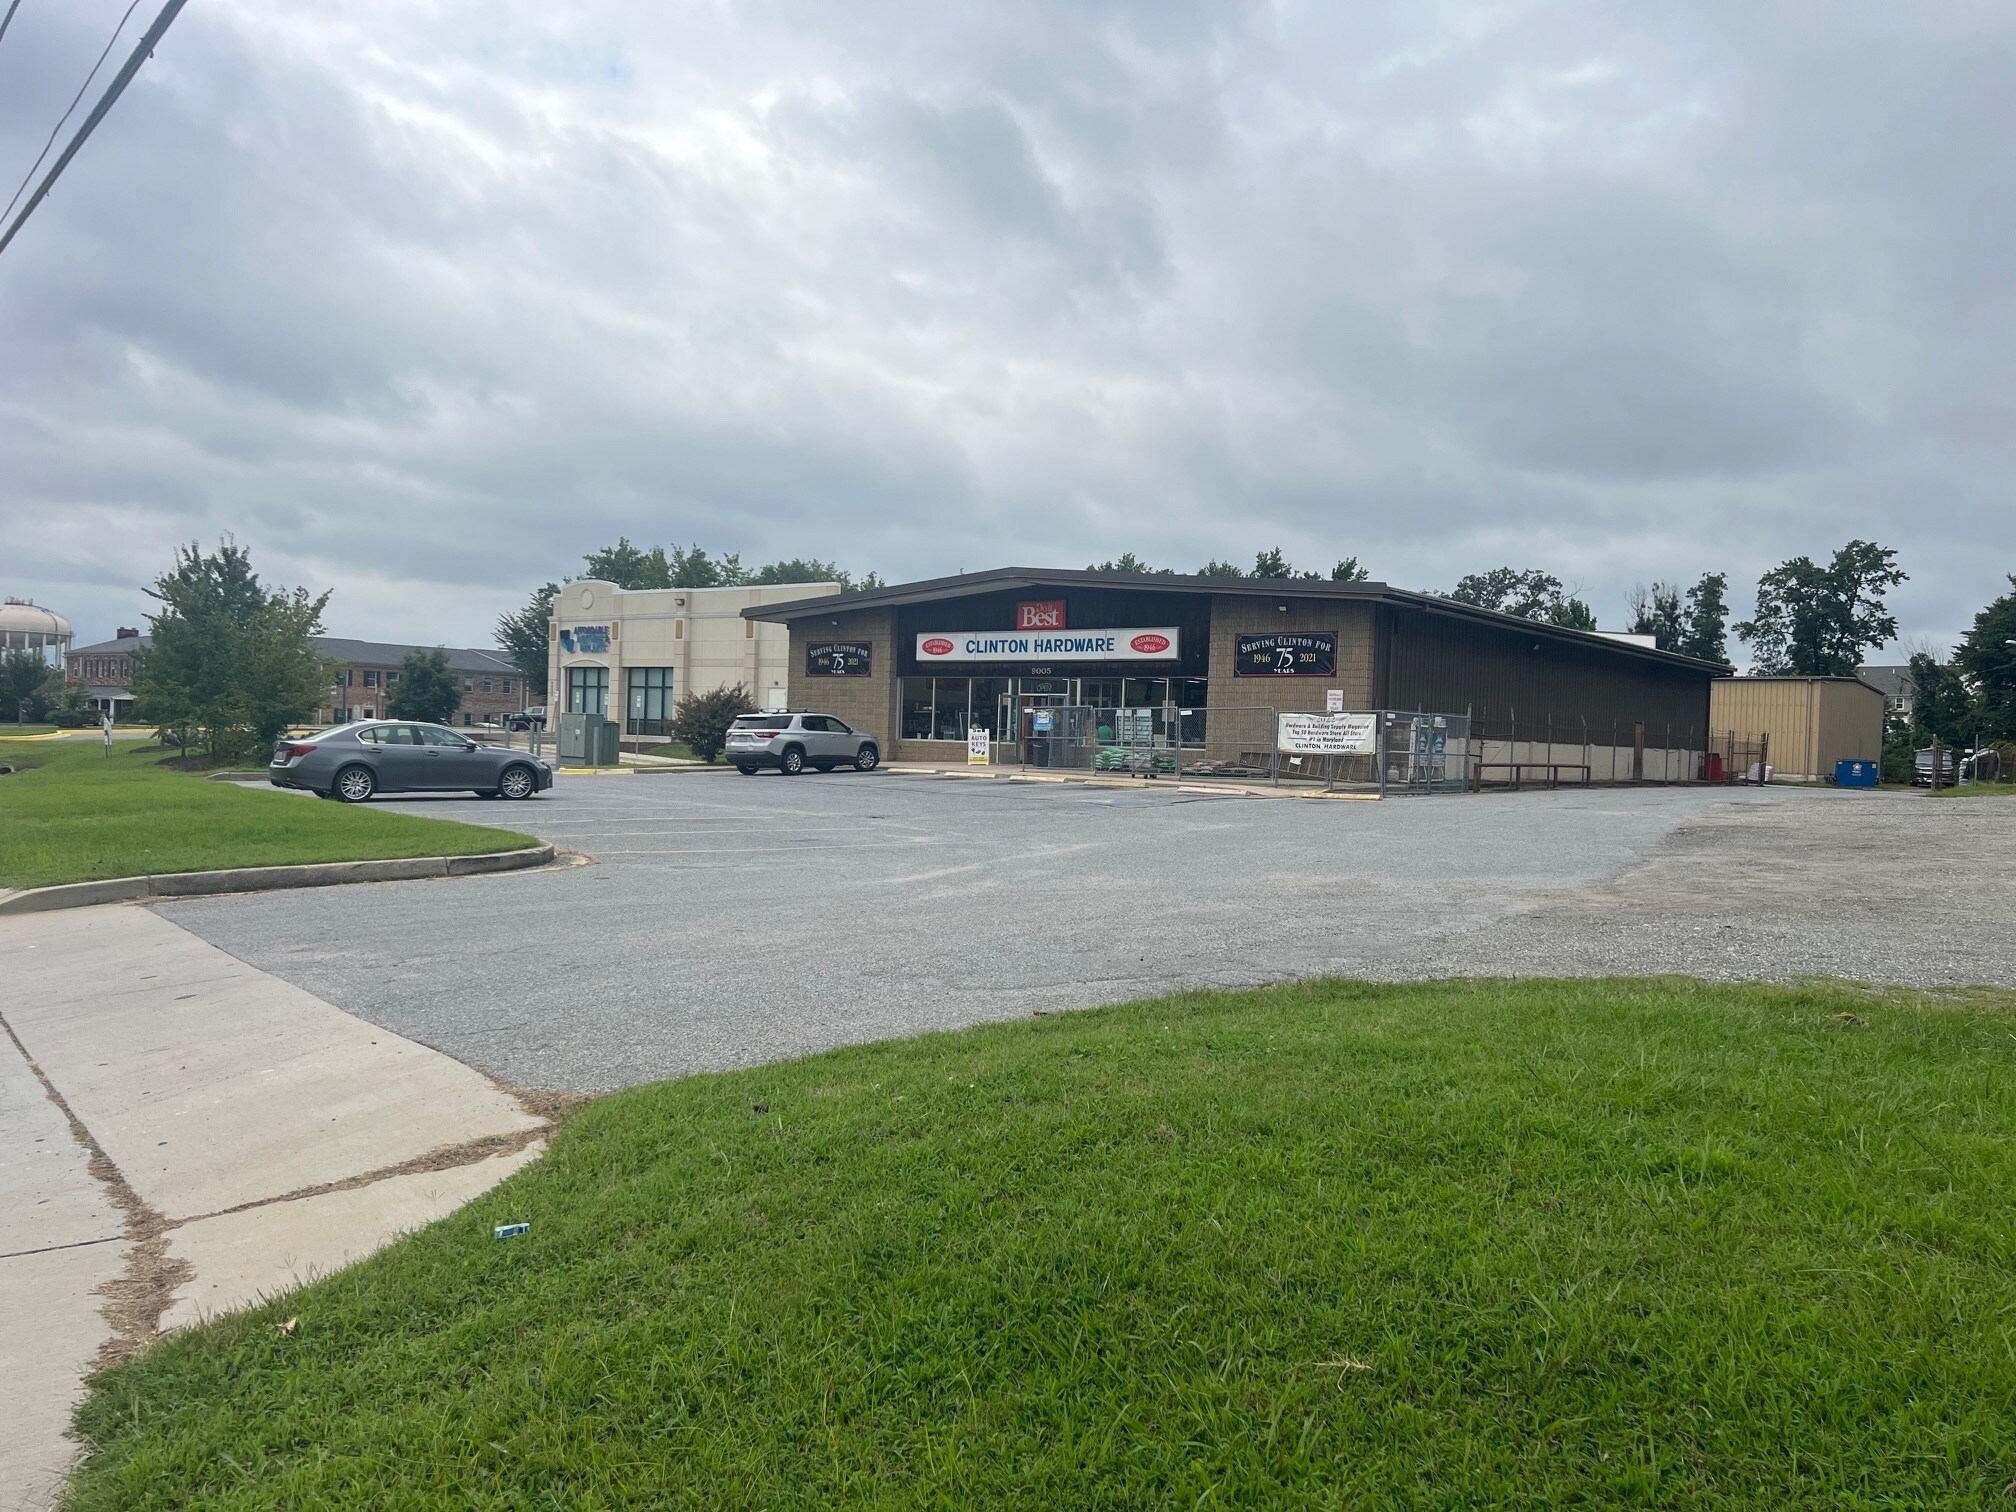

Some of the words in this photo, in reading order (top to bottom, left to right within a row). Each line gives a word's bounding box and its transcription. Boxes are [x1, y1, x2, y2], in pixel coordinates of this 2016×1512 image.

[1021, 606, 1060, 628] Best
[965, 639, 1029, 654] CLINTON
[1033, 637, 1115, 653] HARDWARE
[1134, 635, 1167, 646] ESTABLISHED
[1143, 644, 1156, 652] 1946
[1277, 636, 1313, 647] CLINTON
[1315, 640, 1332, 652] FOR
[832, 653, 844, 670] 75
[1253, 653, 1271, 664] 1946
[1276, 647, 1294, 668] 75
[1299, 652, 1316, 663] 2021
[1031, 667, 1052, 675] 9005
[1036, 682, 1052, 692] OPEN
